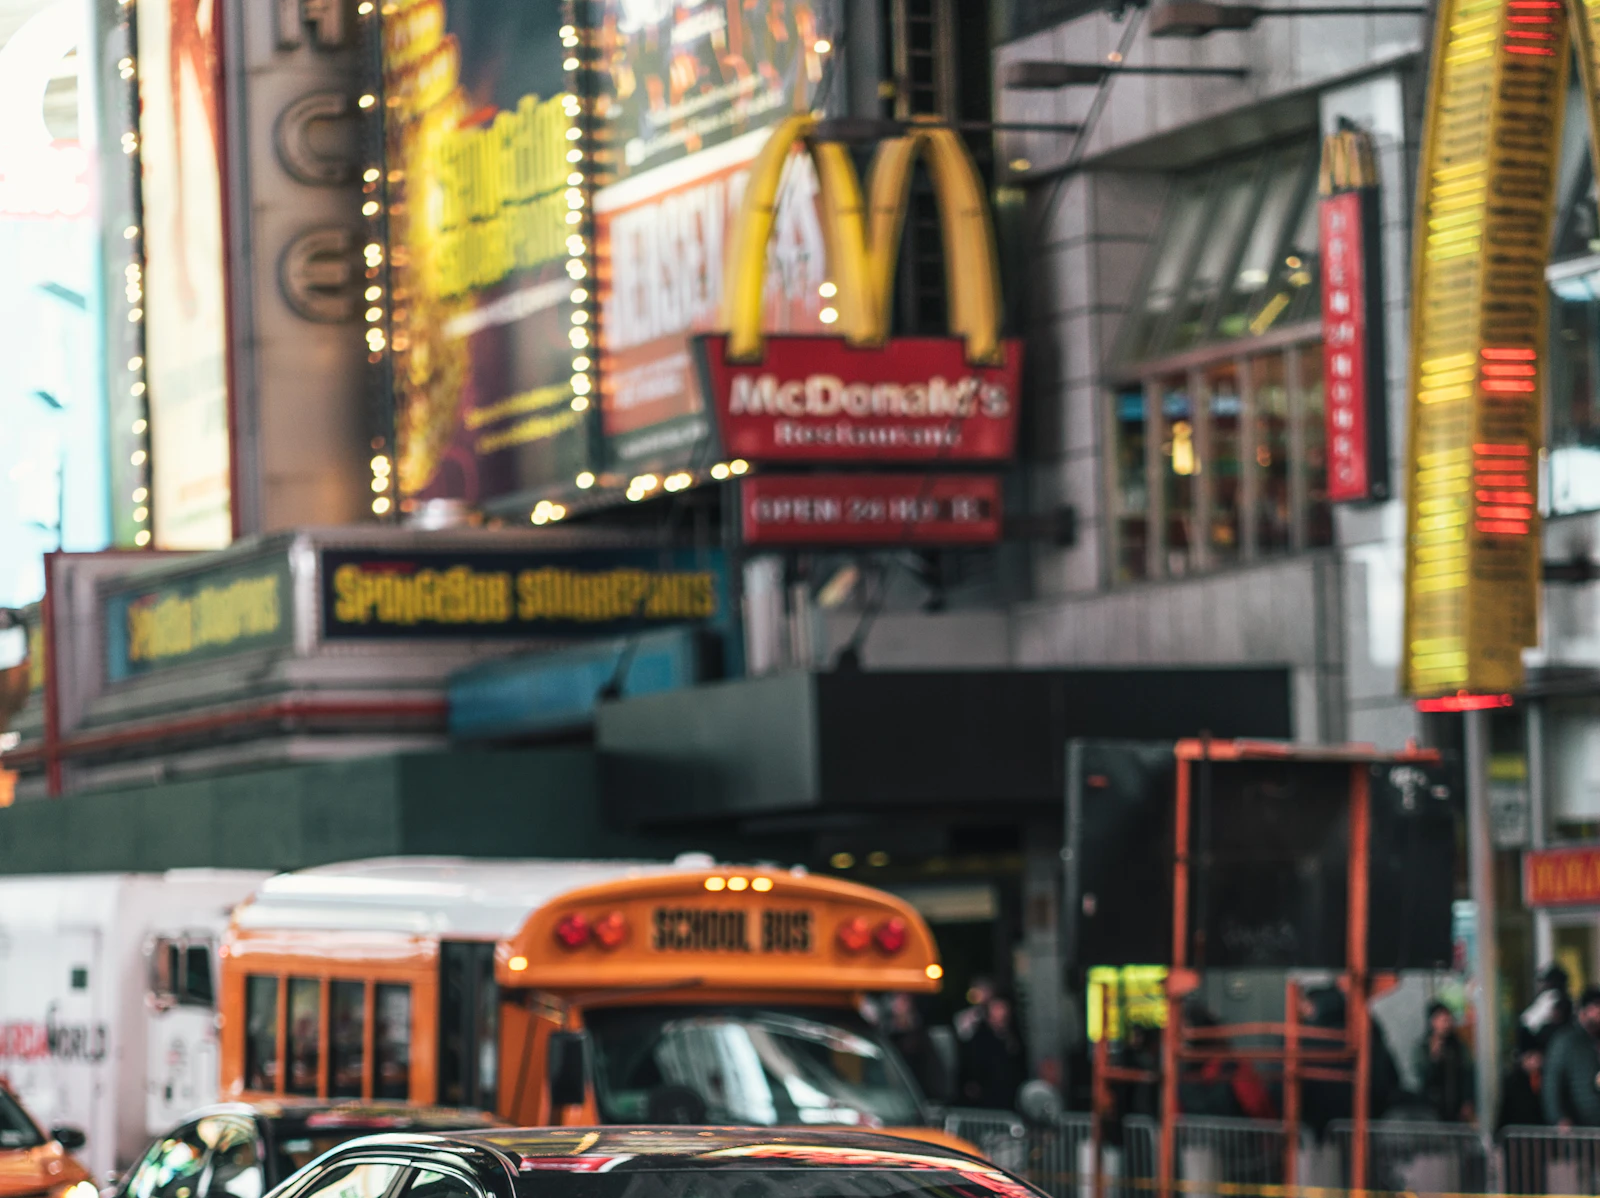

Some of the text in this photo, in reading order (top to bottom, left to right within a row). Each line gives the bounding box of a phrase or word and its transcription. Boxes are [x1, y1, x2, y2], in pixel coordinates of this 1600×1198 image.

[729, 374, 1011, 418] McDonald's
[654, 907, 813, 952] SCHOOL BUS
